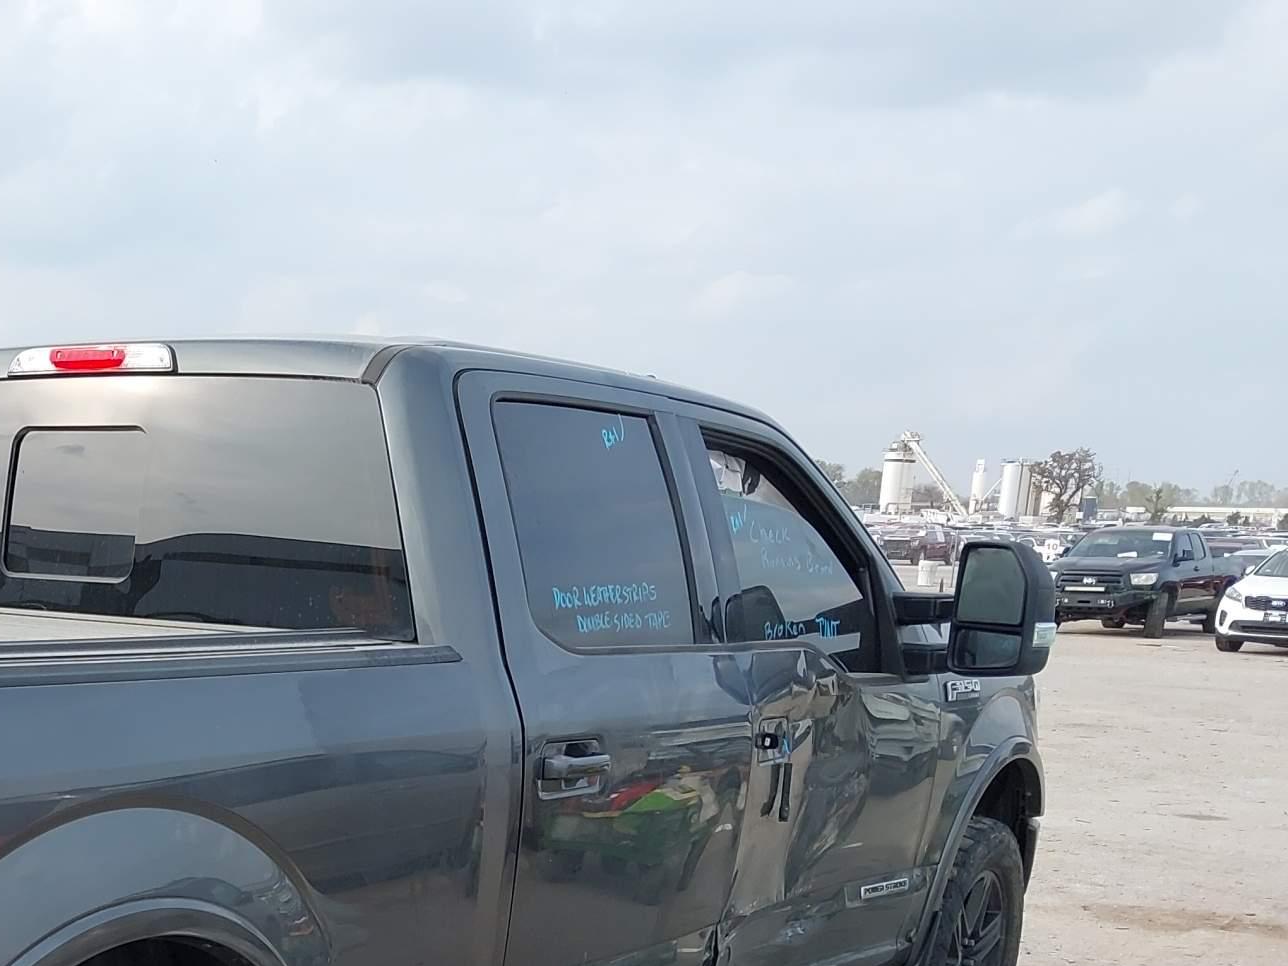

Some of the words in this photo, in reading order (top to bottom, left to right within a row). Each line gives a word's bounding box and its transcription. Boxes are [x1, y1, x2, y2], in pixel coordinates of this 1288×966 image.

[552, 586, 582, 609] DOOR
[613, 612, 643, 632] SIDED
[645, 610, 671, 630] TAPE
[764, 620, 806, 641] Broken
